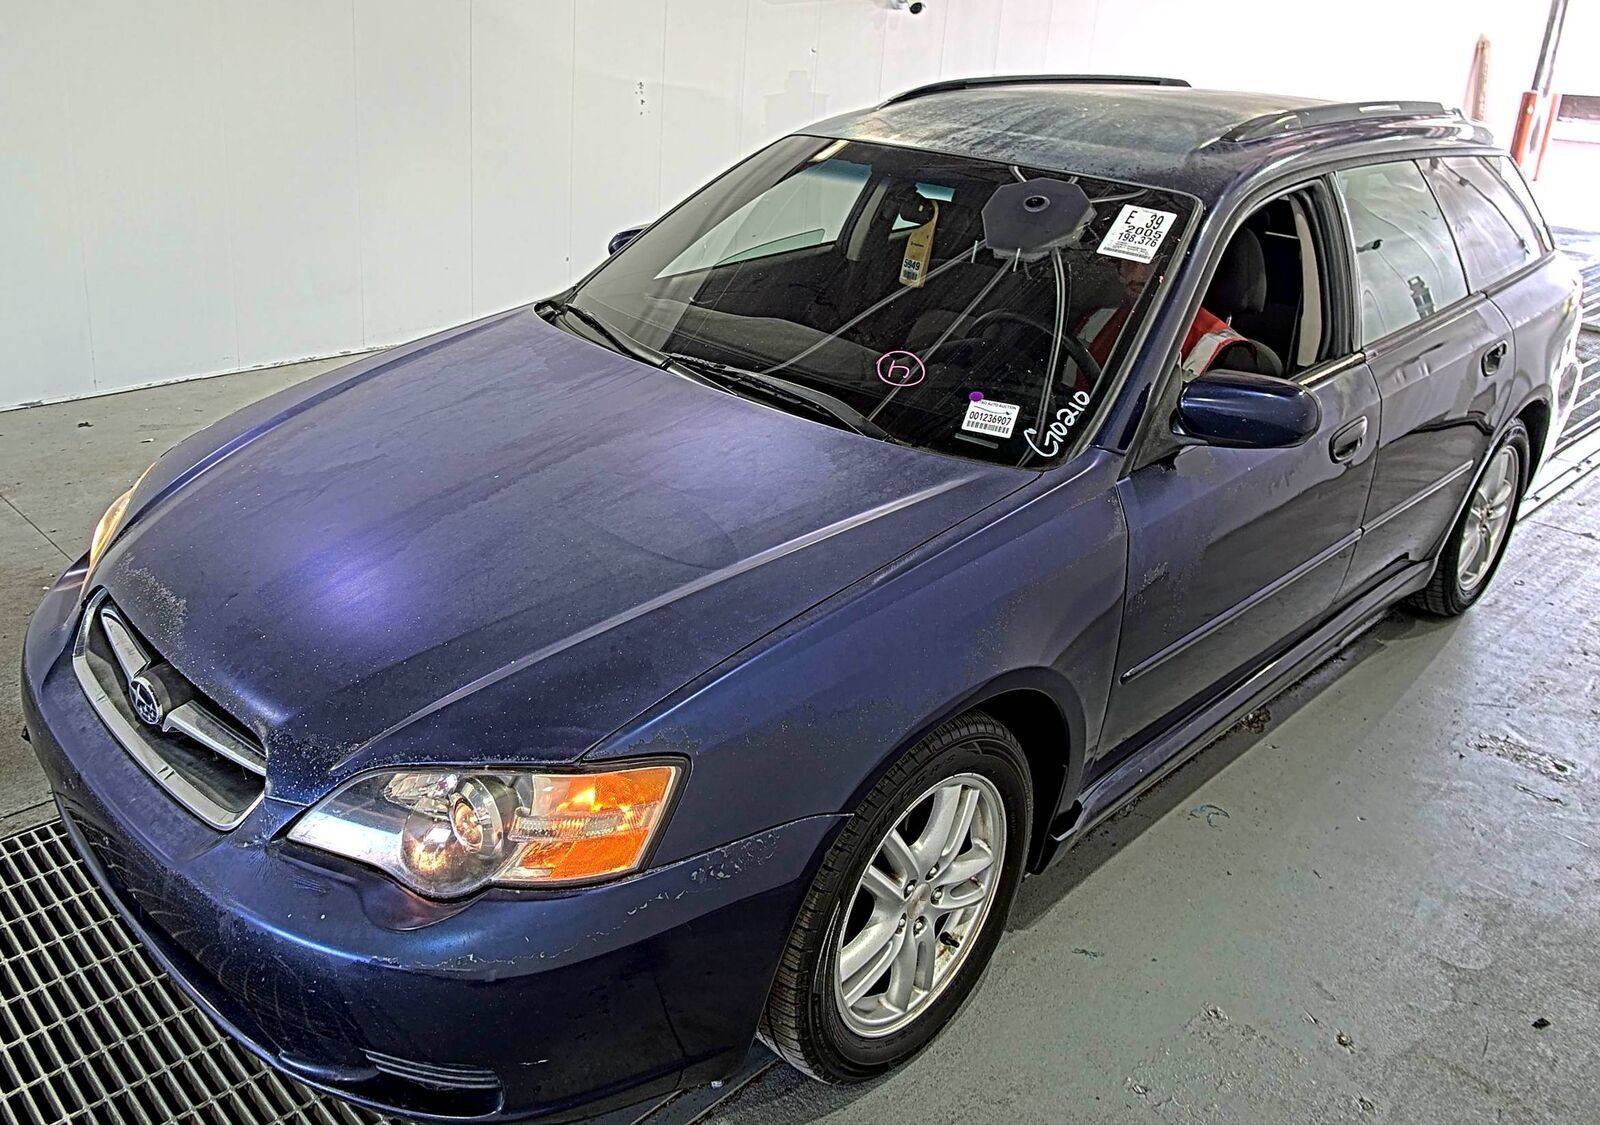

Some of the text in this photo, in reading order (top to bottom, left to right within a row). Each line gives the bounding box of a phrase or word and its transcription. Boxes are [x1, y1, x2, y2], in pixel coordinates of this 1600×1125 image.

[1125, 210, 1164, 230] E 39
[1125, 225, 1163, 239] 2005
[969, 411, 1012, 426] 001236907
